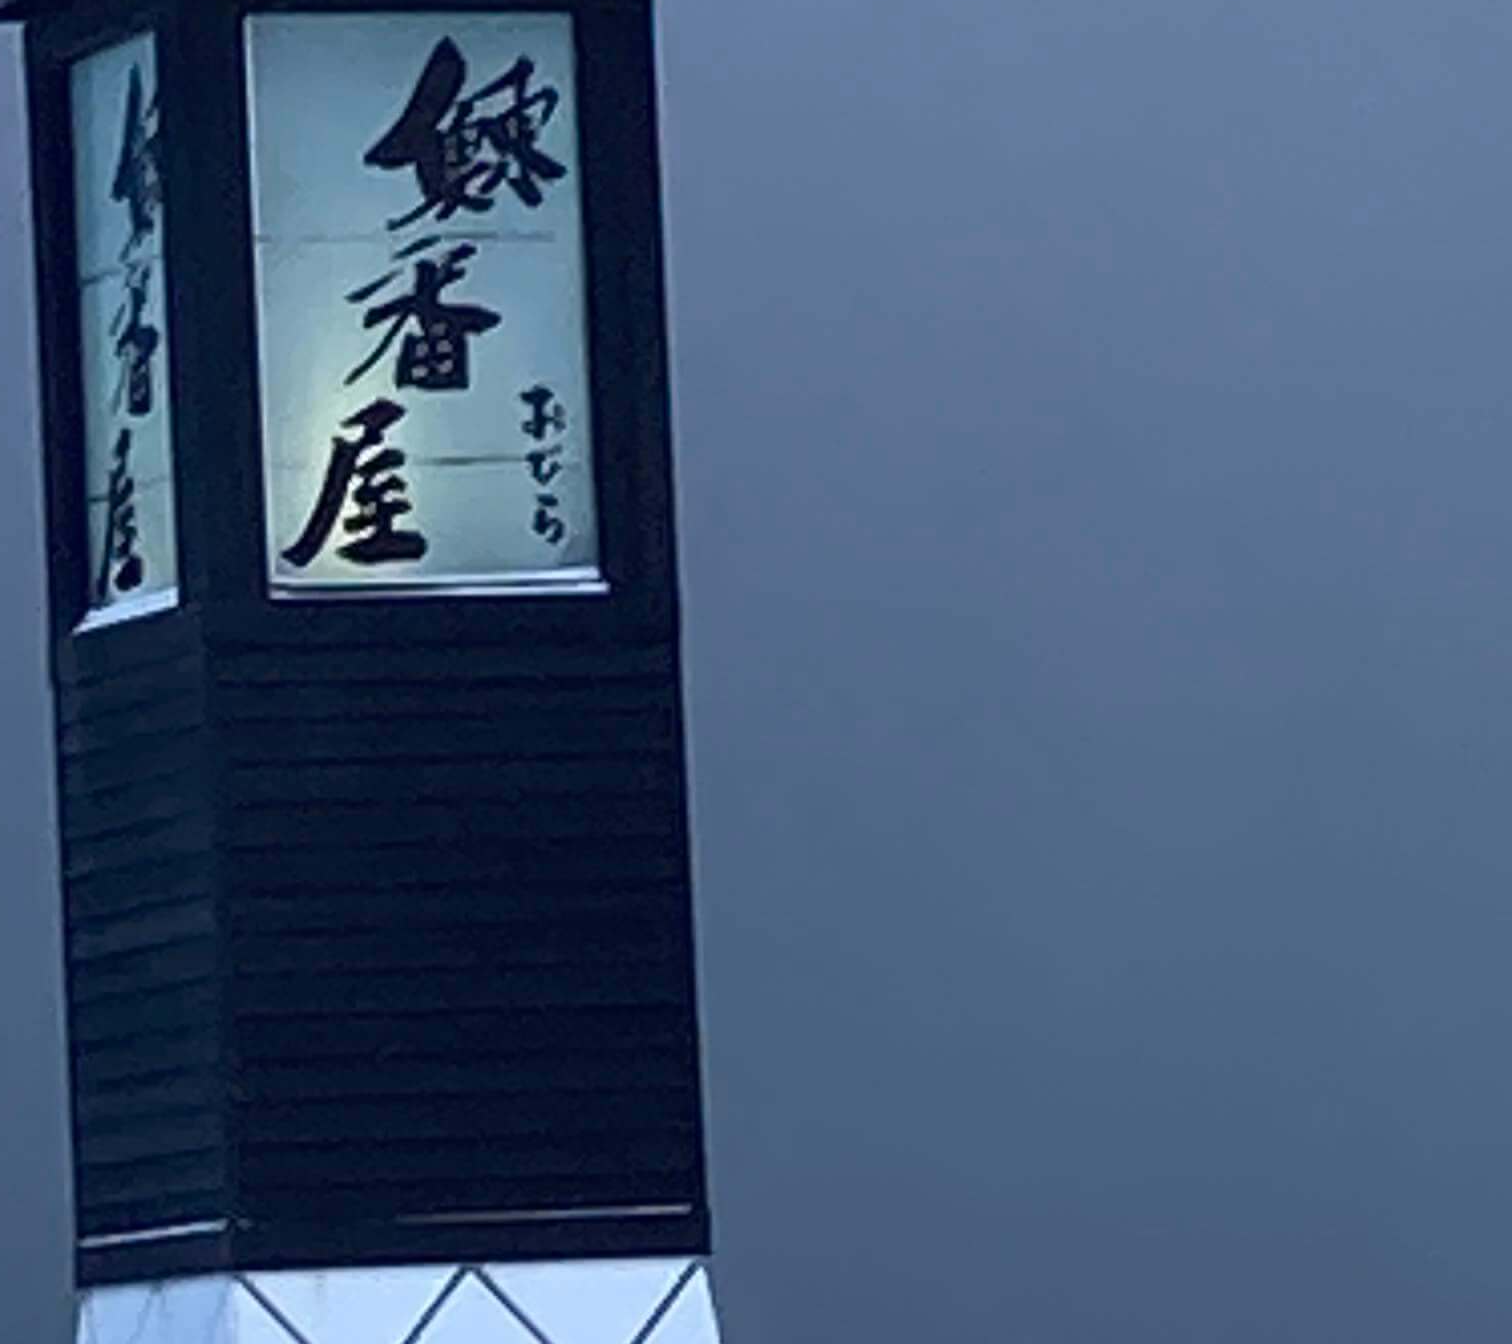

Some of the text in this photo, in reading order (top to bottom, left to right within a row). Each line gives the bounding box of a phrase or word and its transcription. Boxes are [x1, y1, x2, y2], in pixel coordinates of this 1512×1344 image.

[280, 35, 568, 568] 鰊番屋
[519, 384, 567, 545] おびら
